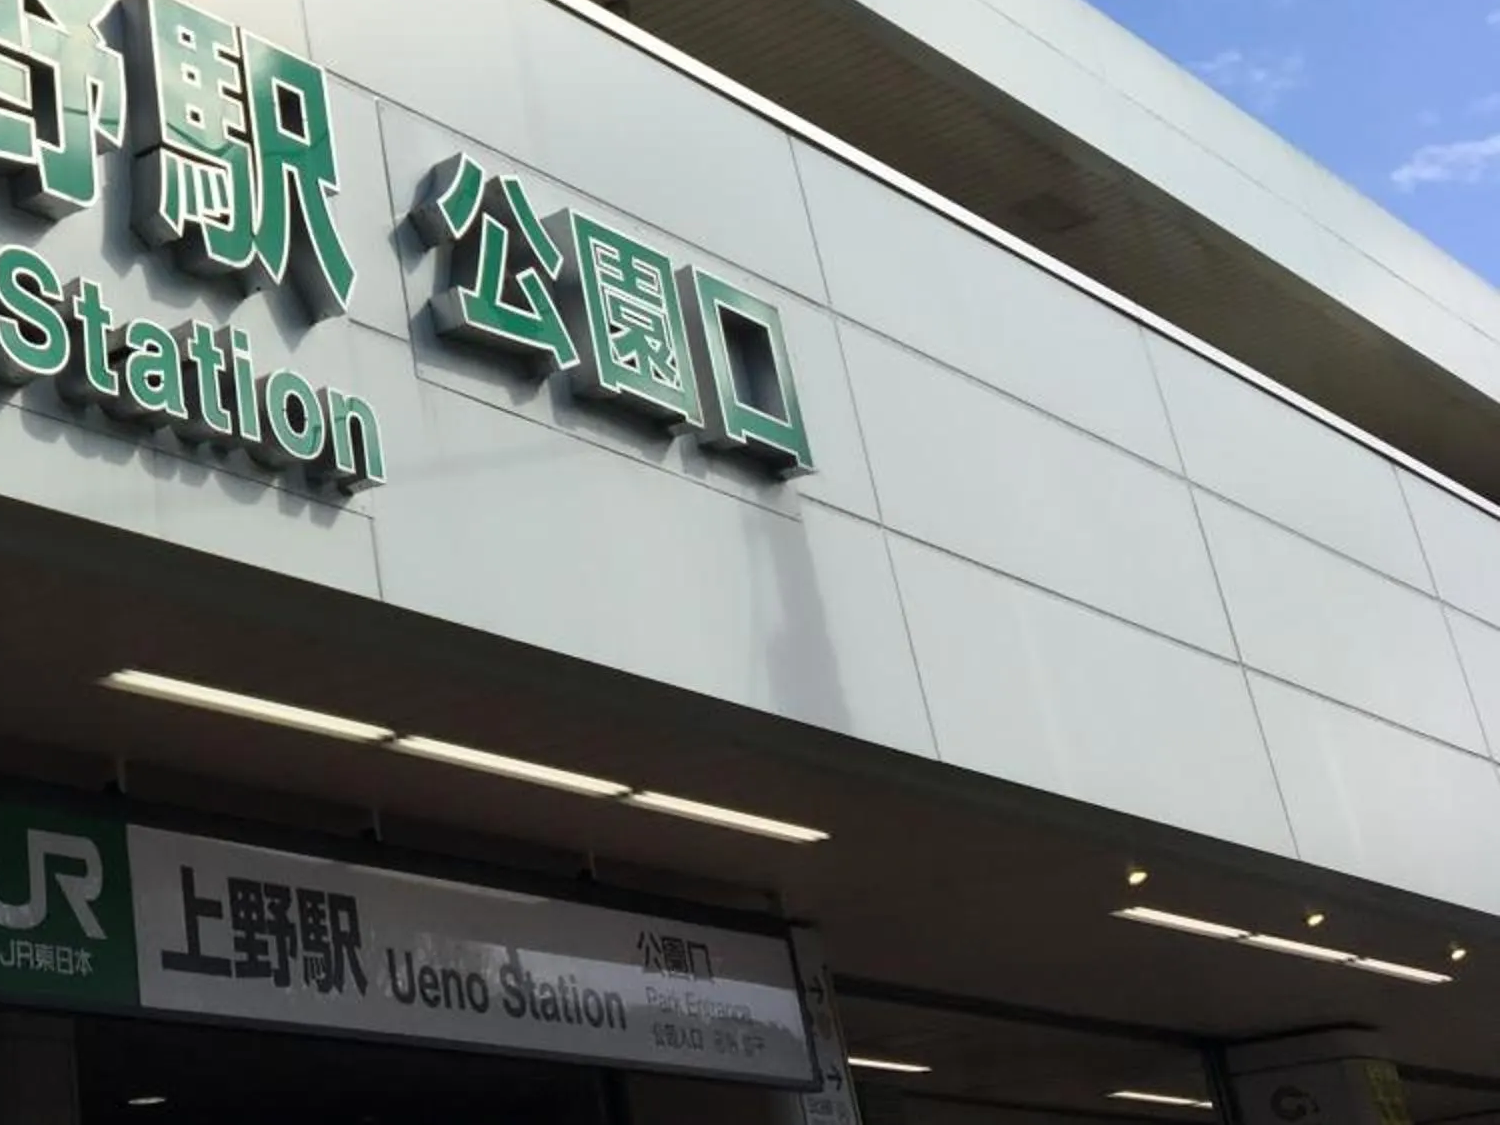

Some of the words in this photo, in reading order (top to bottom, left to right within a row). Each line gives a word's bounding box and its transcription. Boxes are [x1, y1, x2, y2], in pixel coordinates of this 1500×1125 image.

[437, 152, 816, 474] 公園口
[161, 864, 369, 998] 上野駅
[386, 948, 490, 1014] Ueno
[501, 963, 627, 1030] Station
